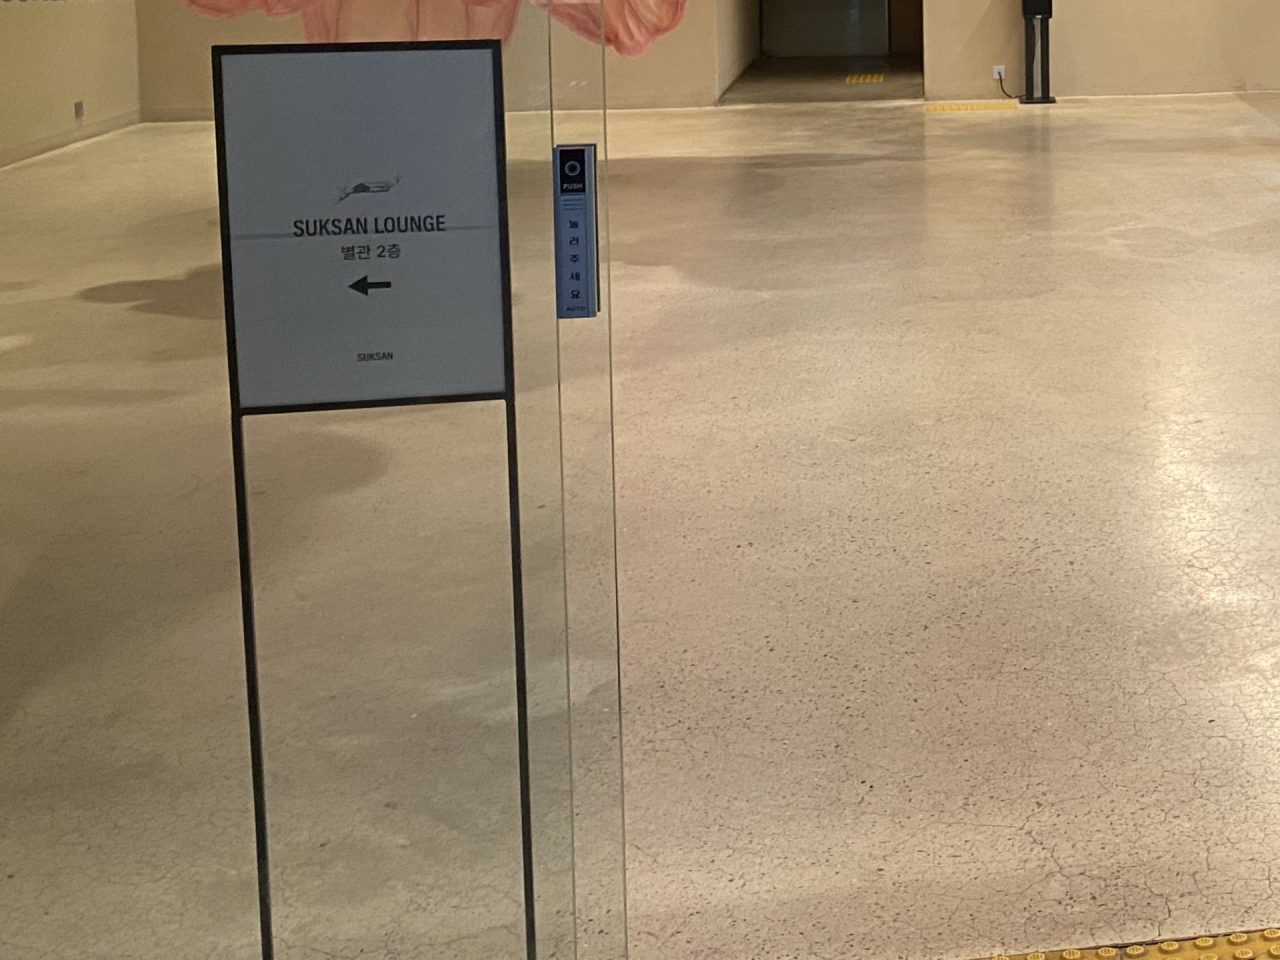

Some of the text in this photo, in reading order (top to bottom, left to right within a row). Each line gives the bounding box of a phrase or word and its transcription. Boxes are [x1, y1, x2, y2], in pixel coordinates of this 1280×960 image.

[293, 214, 447, 238] SUKSAN LOUNGE
[341, 243, 401, 261] 별관 2층
[357, 351, 394, 362] SUKSAN
